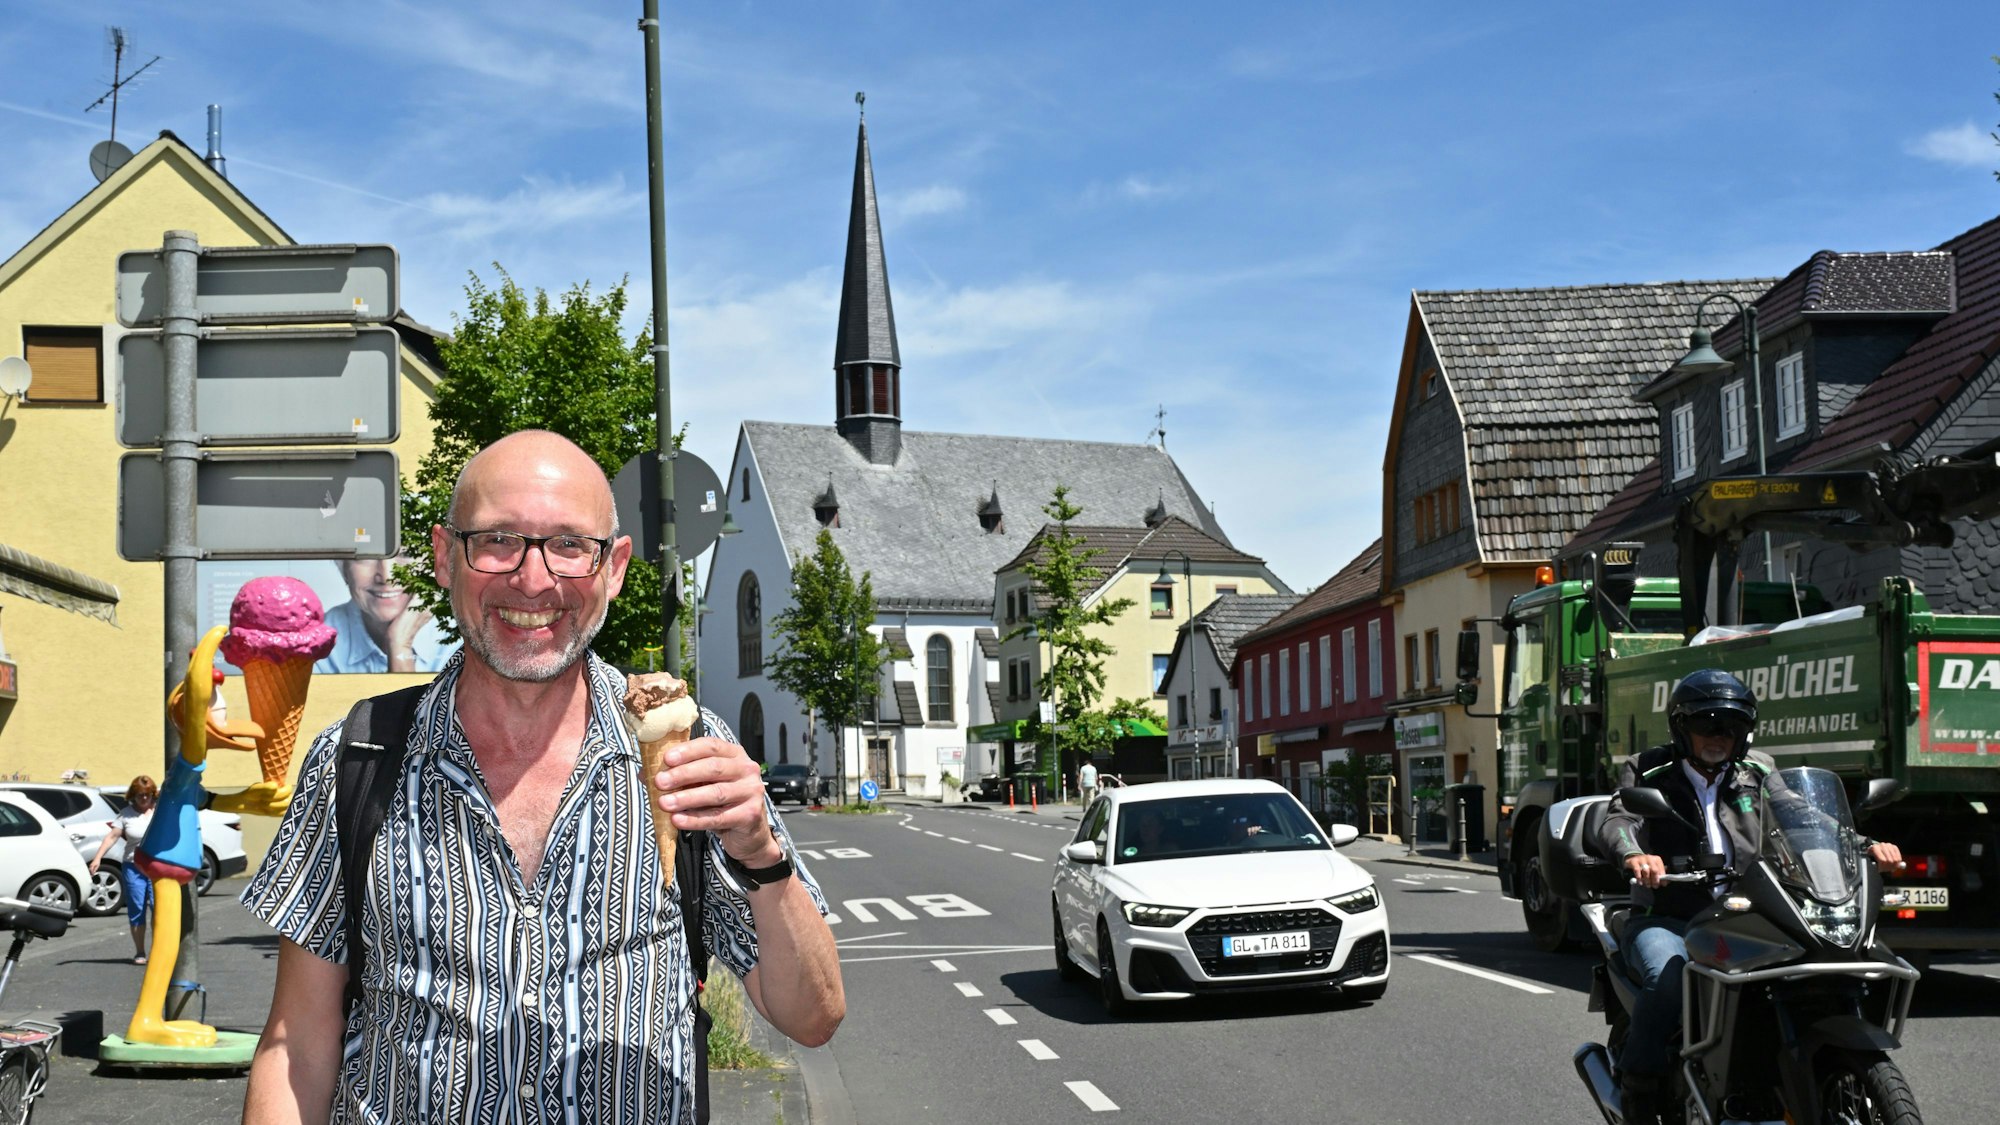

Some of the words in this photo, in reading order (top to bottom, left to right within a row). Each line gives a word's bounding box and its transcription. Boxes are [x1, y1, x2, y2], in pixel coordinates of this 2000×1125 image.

[1914, 889, 1946, 905] 1186
[826, 893, 992, 925] BU
[1232, 938, 1251, 953] GL
[1261, 936, 1279, 951] TA
[1282, 934, 1307, 949] 811
